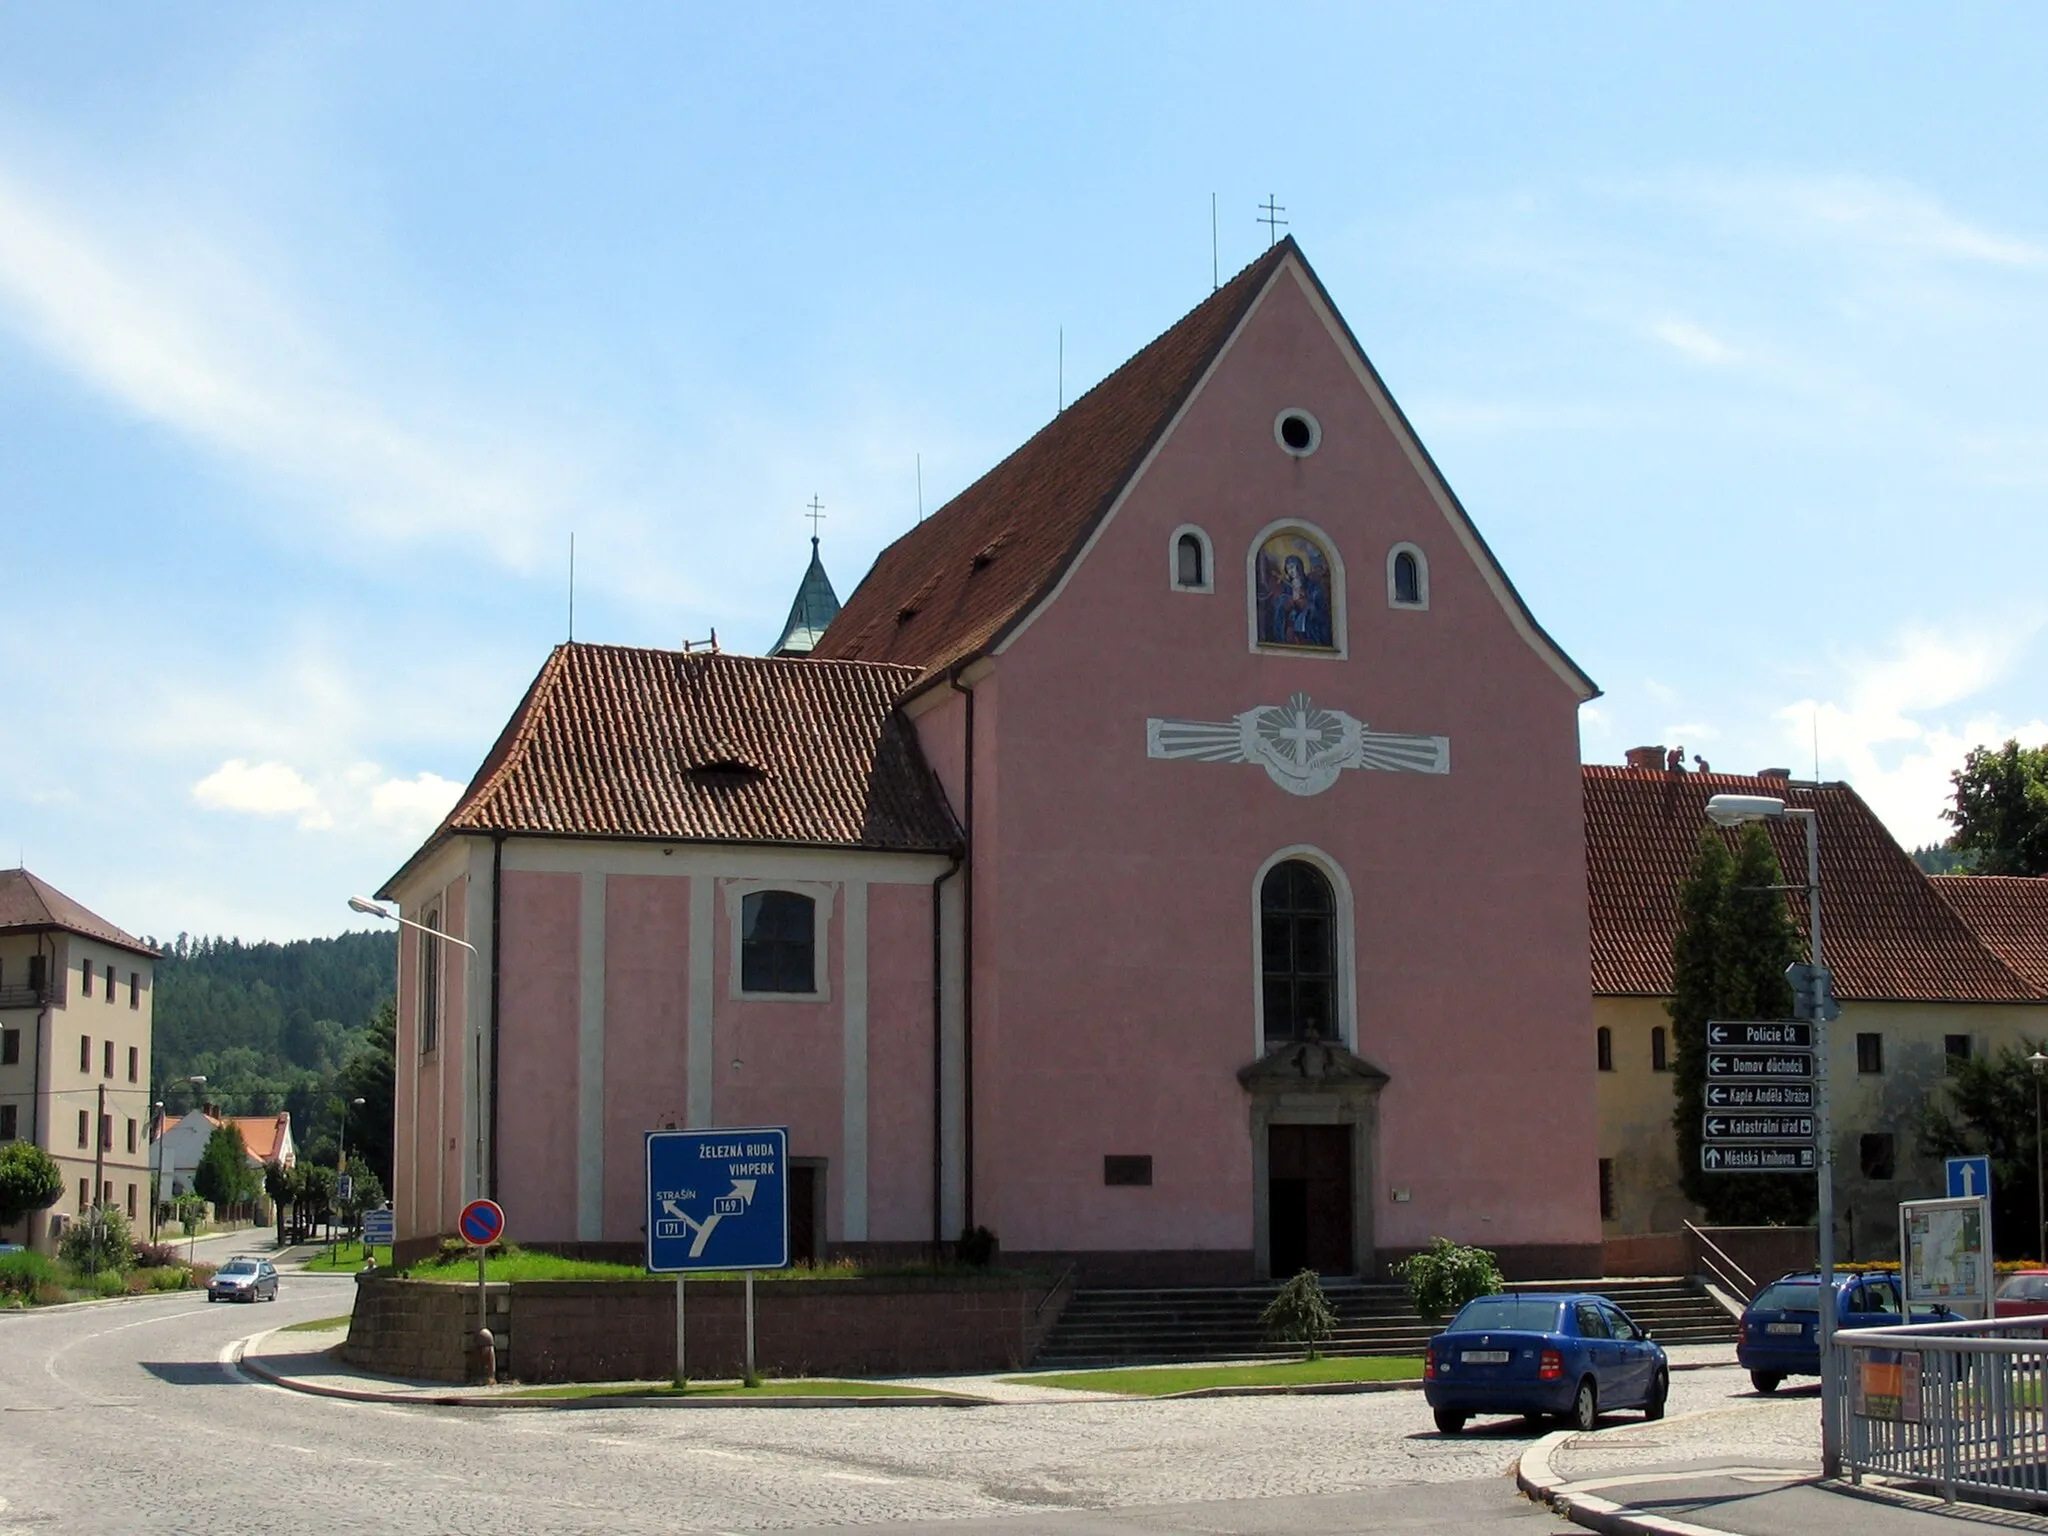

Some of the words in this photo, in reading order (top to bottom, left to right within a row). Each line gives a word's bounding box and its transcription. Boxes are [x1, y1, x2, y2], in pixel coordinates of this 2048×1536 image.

[1746, 1026, 1781, 1042] Policie
[1784, 1025, 1796, 1042] ČR
[1733, 1057, 1763, 1073] Domov
[1729, 1088, 1753, 1105] Kaple
[1729, 1119, 1779, 1134] Katastrální
[699, 1143, 743, 1158] ŽELEZNÁ
[747, 1143, 774, 1157] RUDA
[1724, 1150, 1759, 1165] Městská
[1761, 1150, 1796, 1165] knihovna
[729, 1163, 775, 1176] VIMPERK
[656, 1188, 696, 1201] STRAŠÍN
[720, 1199, 736, 1212] 169
[664, 1223, 678, 1235] 171
